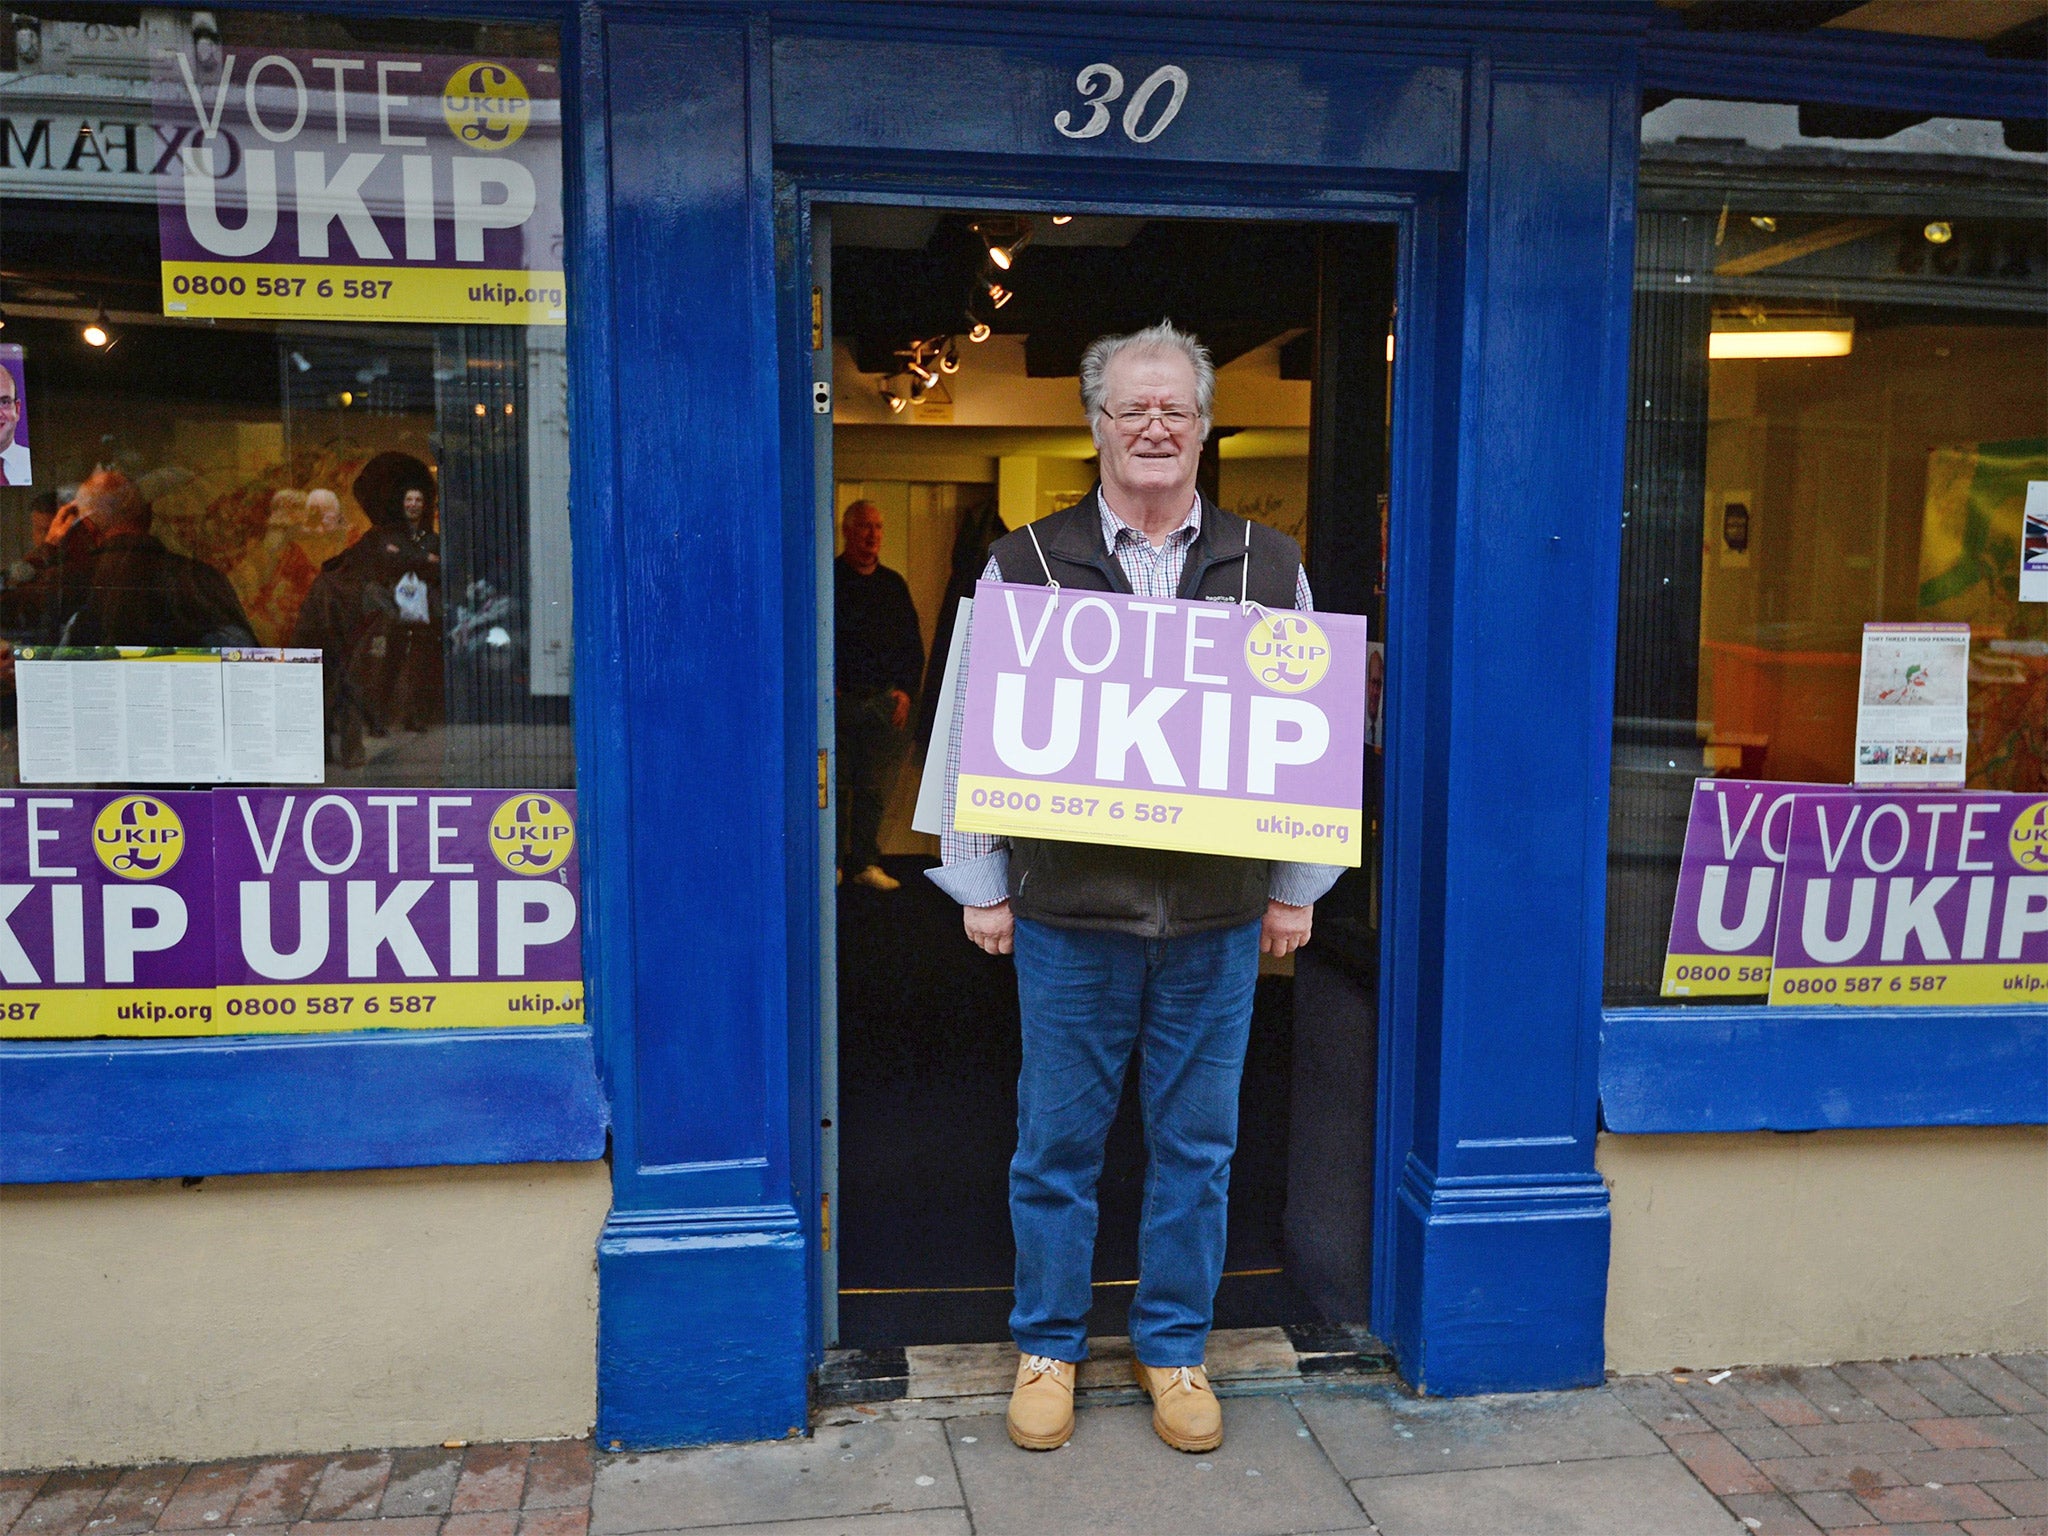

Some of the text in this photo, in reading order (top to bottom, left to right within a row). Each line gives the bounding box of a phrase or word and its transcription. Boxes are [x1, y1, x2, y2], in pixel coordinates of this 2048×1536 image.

[177, 52, 427, 146] VOTE
[446, 95, 527, 115] UKIP
[1054, 63, 1189, 143] 30
[183, 147, 536, 262] UKIP
[172, 274, 393, 299] 0800 587 6 587
[468, 283, 562, 307] ukip.org
[1004, 590, 1230, 685] VOTE
[1248, 641, 1326, 661] UKIP
[992, 672, 1330, 795] UKIP
[971, 788, 1183, 825] 0800 587 6 587
[0, 798, 77, 877] E
[98, 829, 179, 844] UKIP
[237, 795, 474, 875] VOTE
[493, 824, 570, 841] UKIP
[1256, 815, 1349, 843] ukip.org
[1816, 803, 2000, 873] VOTE
[1697, 865, 1775, 952] U
[1801, 876, 2048, 964] UKIP
[240, 880, 577, 980] UKIP
[1676, 966, 1731, 981] 0800
[1783, 976, 1947, 994] 0800 587 6 587
[2003, 974, 2048, 992] ukip.
[117, 1002, 212, 1022] ukip.org
[226, 995, 437, 1016] 0800 587 6 587
